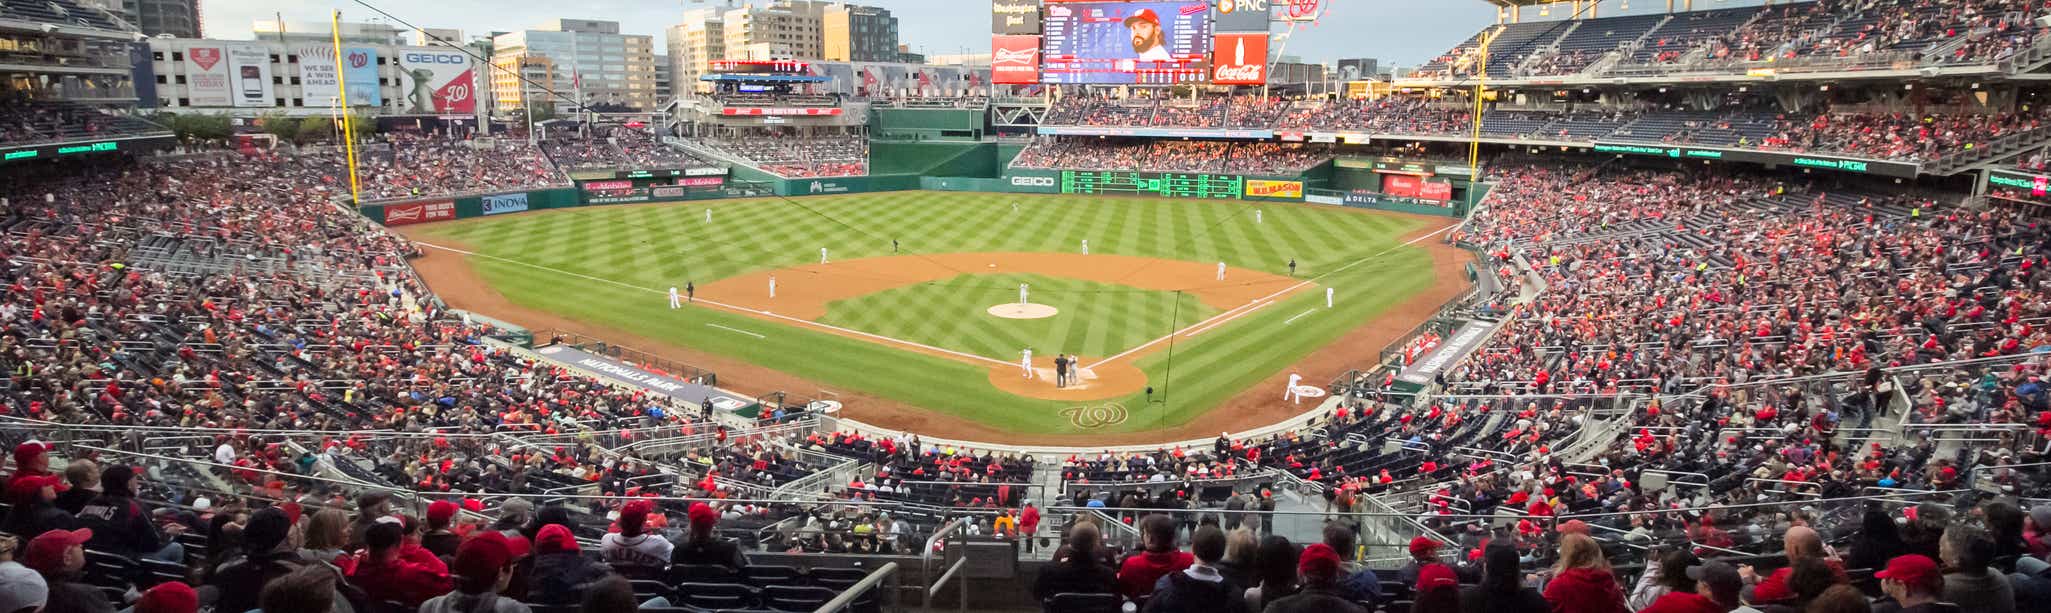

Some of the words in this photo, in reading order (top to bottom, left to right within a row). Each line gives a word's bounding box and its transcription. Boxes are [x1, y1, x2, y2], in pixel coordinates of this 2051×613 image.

[1235, 0, 1267, 11] PNC
[1006, 16, 1024, 26] Post
[406, 53, 464, 64] GEICO
[1215, 63, 1262, 80] Coca-Cola
[1011, 176, 1054, 186] GEICO
[494, 198, 528, 209] INOVA
[1353, 195, 1376, 203] DELTA
[578, 358, 644, 381] NATIONALS
[646, 375, 684, 391] PARK
